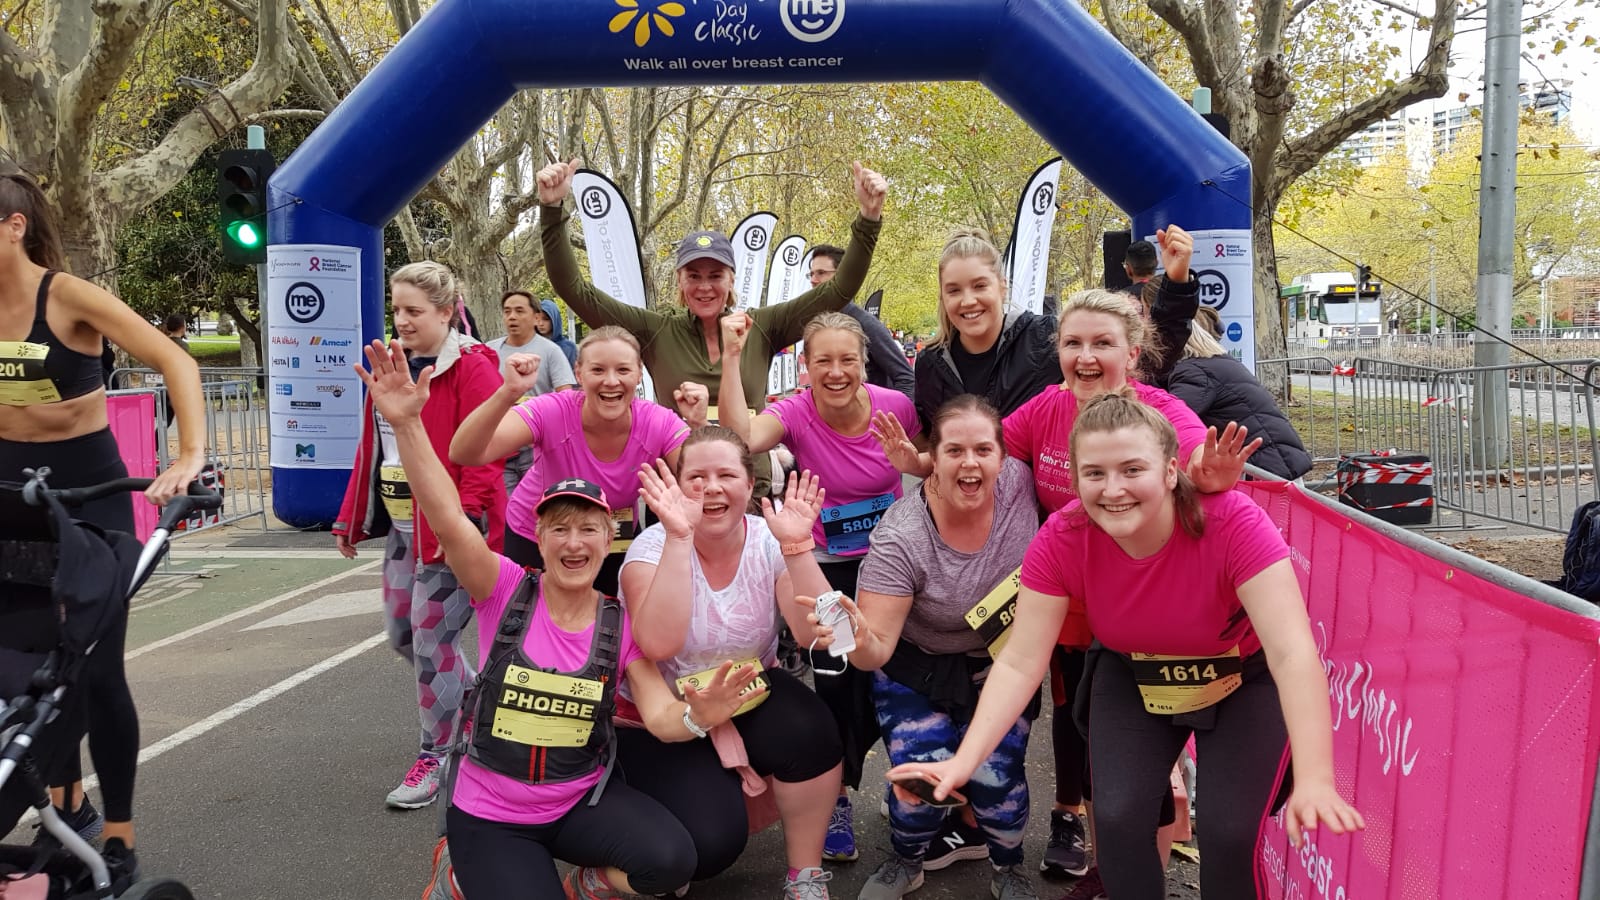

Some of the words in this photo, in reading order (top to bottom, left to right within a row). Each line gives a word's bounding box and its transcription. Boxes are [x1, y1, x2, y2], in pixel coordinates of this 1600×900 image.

[716, 0, 748, 24] Day
[694, 18, 761, 46] Classic
[623, 57, 664, 71] Walk
[668, 57, 688, 70] all
[691, 57, 727, 70] over
[732, 56, 784, 69] breast
[788, 55, 844, 68] cancer
[750, 229, 760, 247] me
[291, 294, 317, 307] me
[315, 354, 346, 364] LINK
[1160, 664, 1218, 682] 1614
[502, 688, 595, 718] PHOEBE
